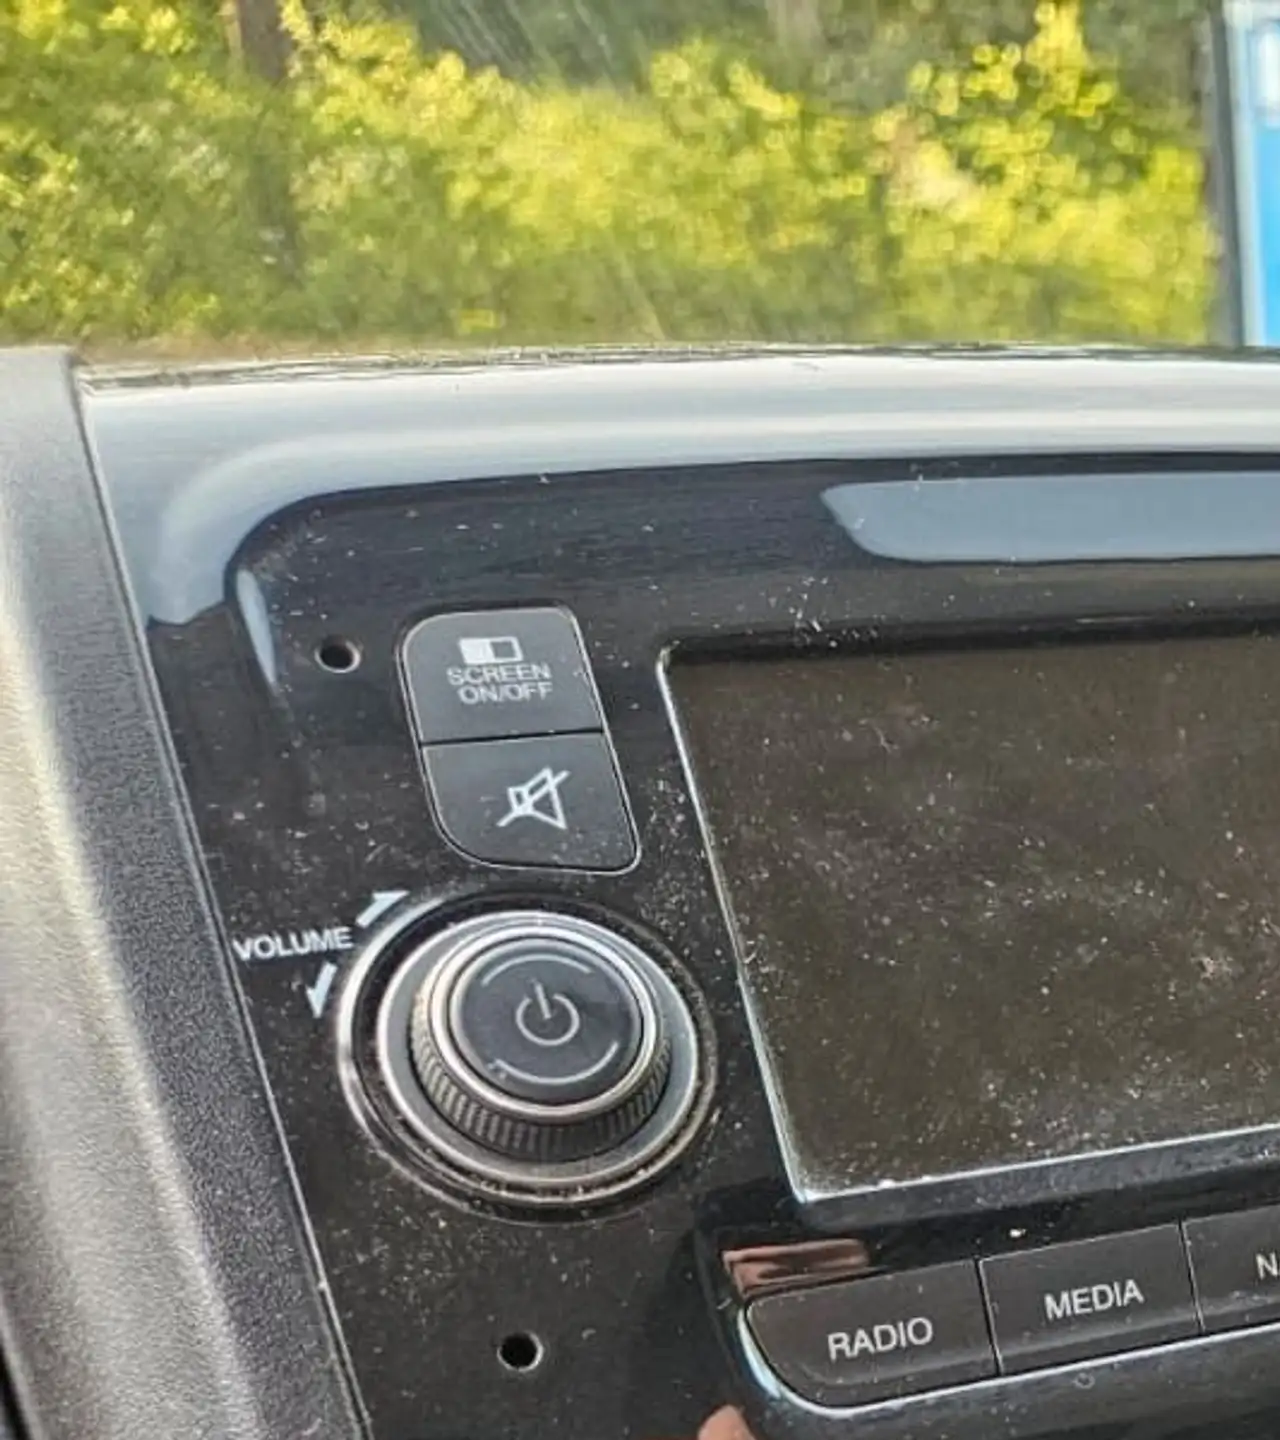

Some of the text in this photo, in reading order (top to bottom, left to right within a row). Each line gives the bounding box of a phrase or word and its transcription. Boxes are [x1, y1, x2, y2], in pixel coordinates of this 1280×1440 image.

[446, 663, 552, 687] SCREEN
[457, 682, 553, 705] ON/OFF
[232, 926, 355, 962] VOLUME
[1044, 1278, 1145, 1321] MEDIA
[827, 1317, 935, 1361] RADIO
